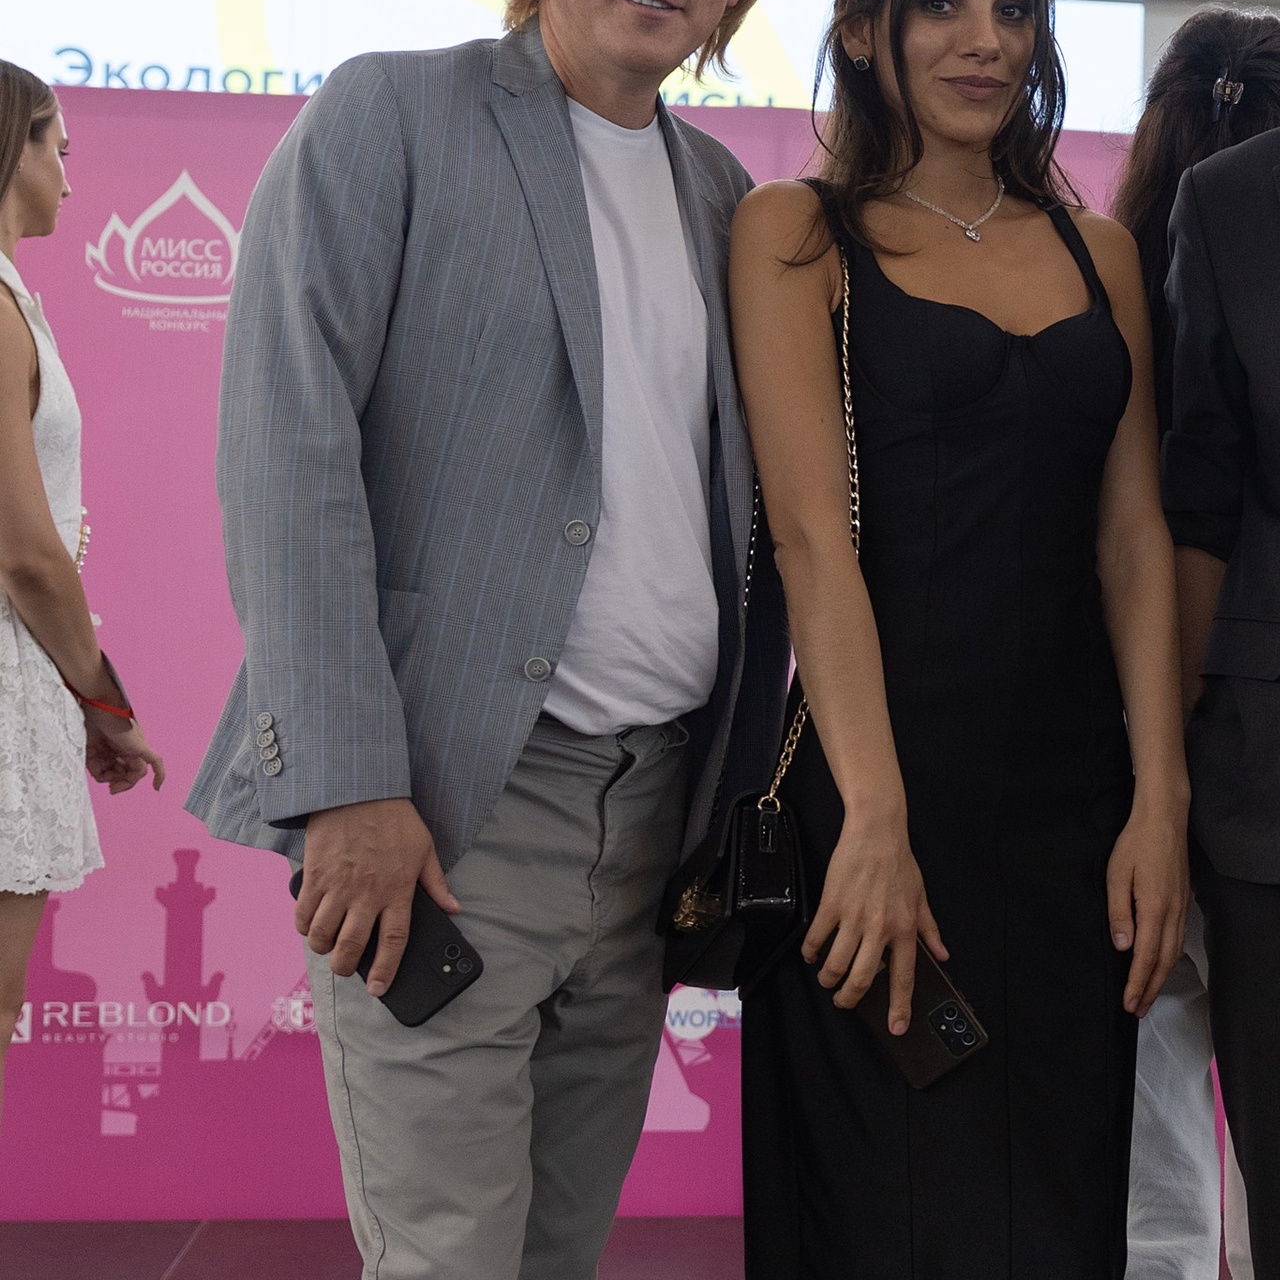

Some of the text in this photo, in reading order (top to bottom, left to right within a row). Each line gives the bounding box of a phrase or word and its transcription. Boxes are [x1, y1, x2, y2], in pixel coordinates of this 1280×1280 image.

[140, 236, 223, 262] МИСС
[140, 259, 223, 280] РОССИЯ
[149, 319, 209, 333] КОНКУРС
[42, 1001, 232, 1028] REBLOND
[41, 1032, 180, 1044] BEAUTY STUDIO
